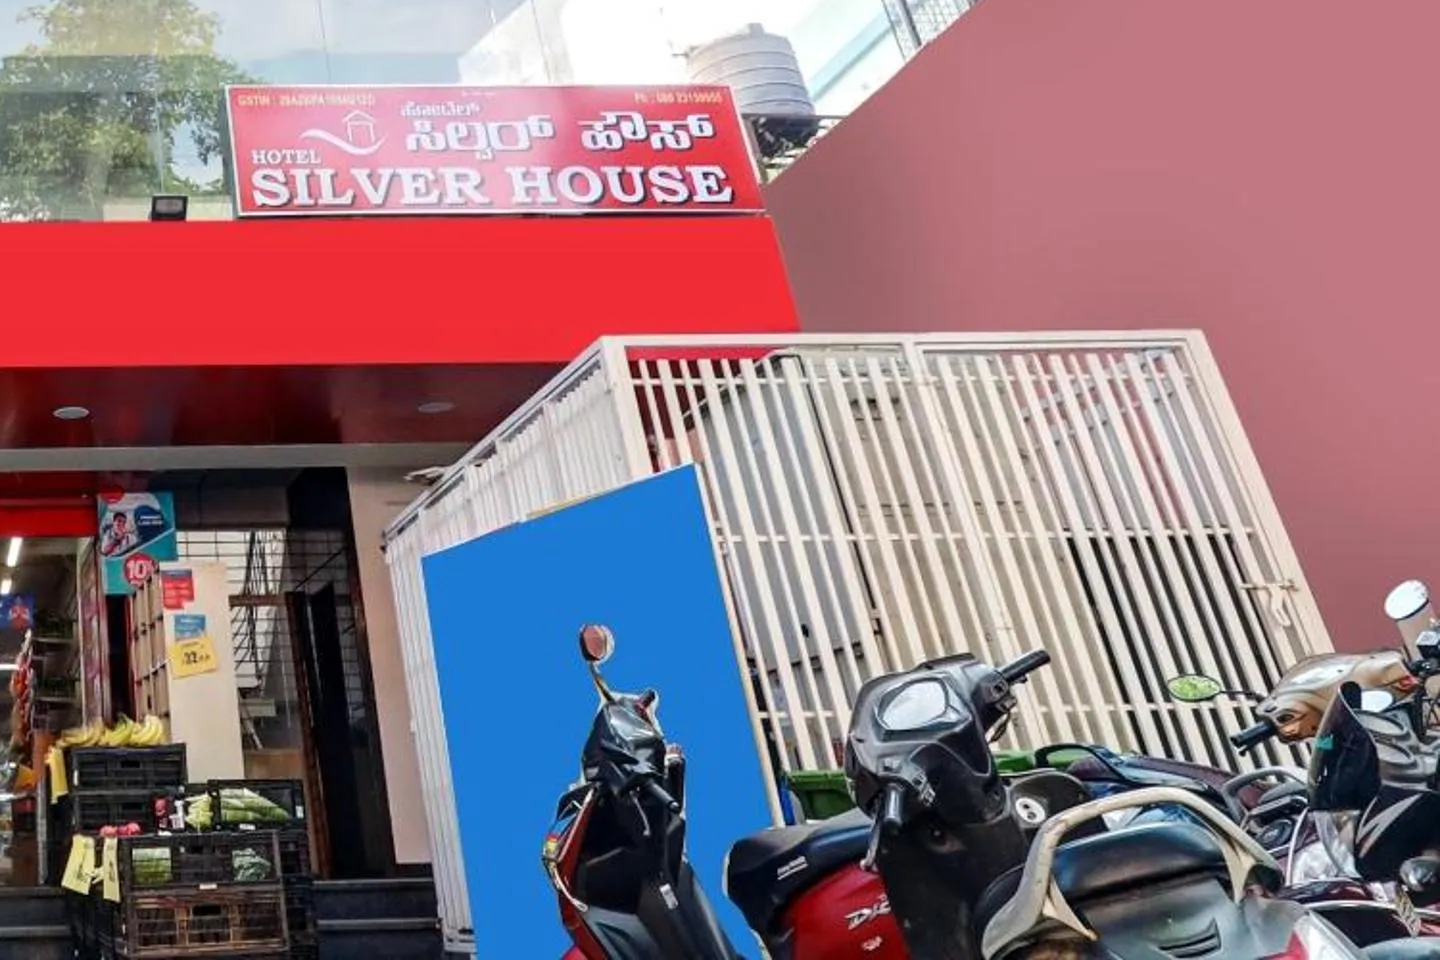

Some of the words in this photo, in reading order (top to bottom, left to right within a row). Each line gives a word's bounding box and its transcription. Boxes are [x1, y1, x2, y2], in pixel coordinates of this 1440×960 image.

[251, 149, 321, 165] HOTEL
[405, 115, 555, 161] ಸಿಲ್ವರ್
[577, 111, 714, 150] ಹೌಸ್
[251, 166, 492, 207] SILVER
[505, 165, 733, 204] HOUSE
